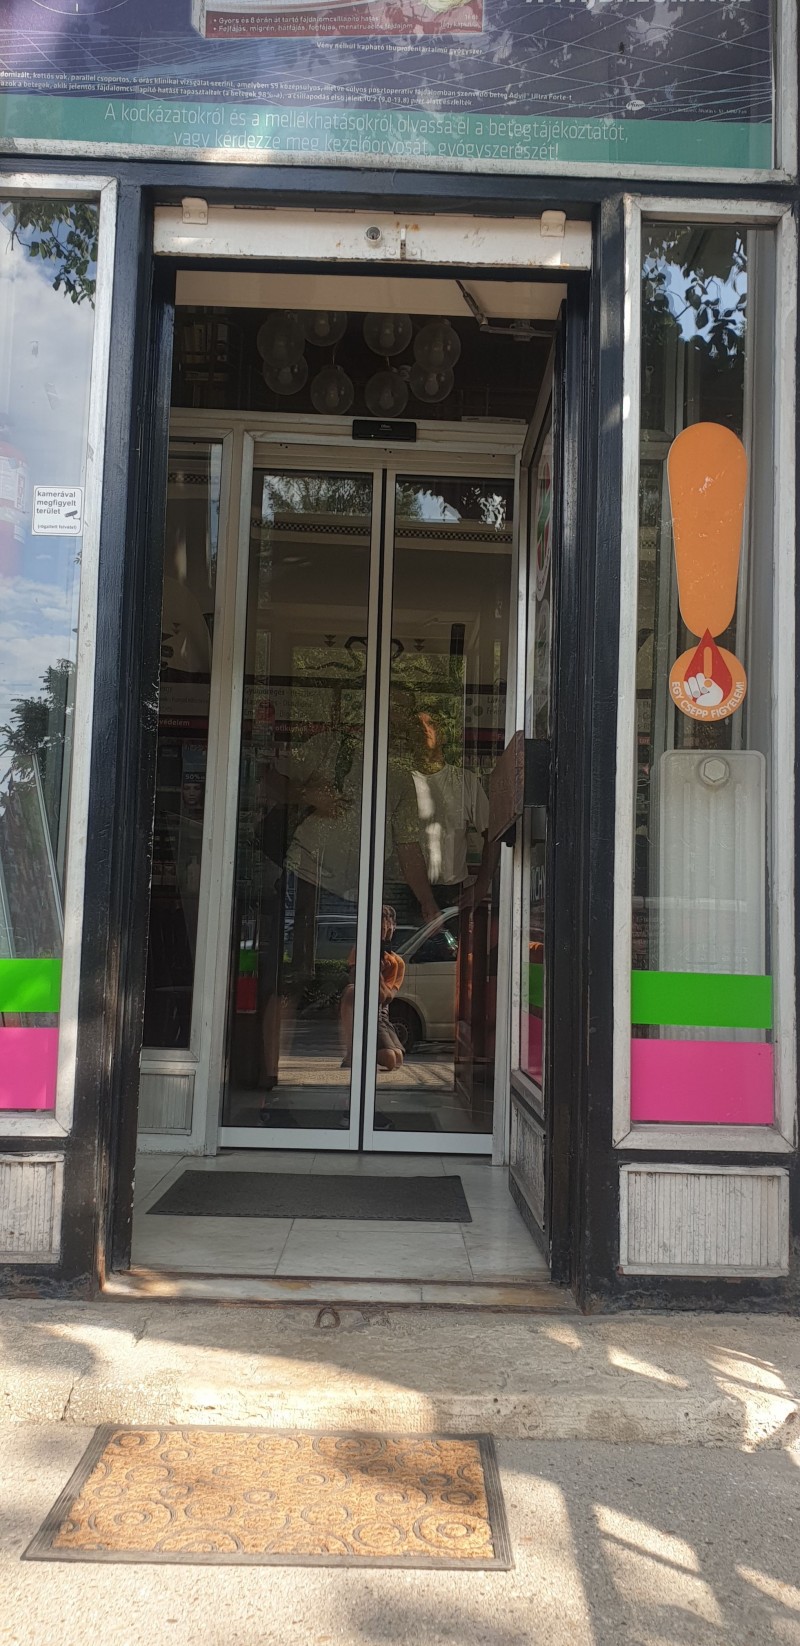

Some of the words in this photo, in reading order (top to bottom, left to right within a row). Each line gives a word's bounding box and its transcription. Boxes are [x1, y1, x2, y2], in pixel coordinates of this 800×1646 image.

[218, 17, 240, 25] Gyors
[317, 41, 333, 50] Vény
[357, 43, 385, 52] kapható
[0, 80, 17, 88] azok
[70, 74, 96, 82] parallel
[489, 91, 508, 101] beteg
[531, 92, 547, 100] Ultra
[104, 103, 116, 121] A
[121, 103, 224, 125] kockázatokról
[230, 109, 246, 126] és
[252, 112, 260, 127] a
[266, 110, 392, 131] mellékhatásokról
[397, 114, 452, 135] olvassa
[457, 118, 470, 136] el
[475, 121, 483, 137] a
[489, 117, 629, 143] betegtájékoztatót,
[174, 131, 210, 148] vagy
[215, 130, 281, 151] kérdezze
[286, 136, 319, 152] meg
[325, 133, 432, 156] kezelőorvosát,
[438, 139, 559, 160] gyógyszerészét!
[37, 490, 76, 498] kamerával
[36, 499, 77, 508] megfigyelt
[672, 681, 684, 699] EGY
[681, 700, 708, 718] CSEPP
[711, 681, 744, 718] FIGYELEM!
